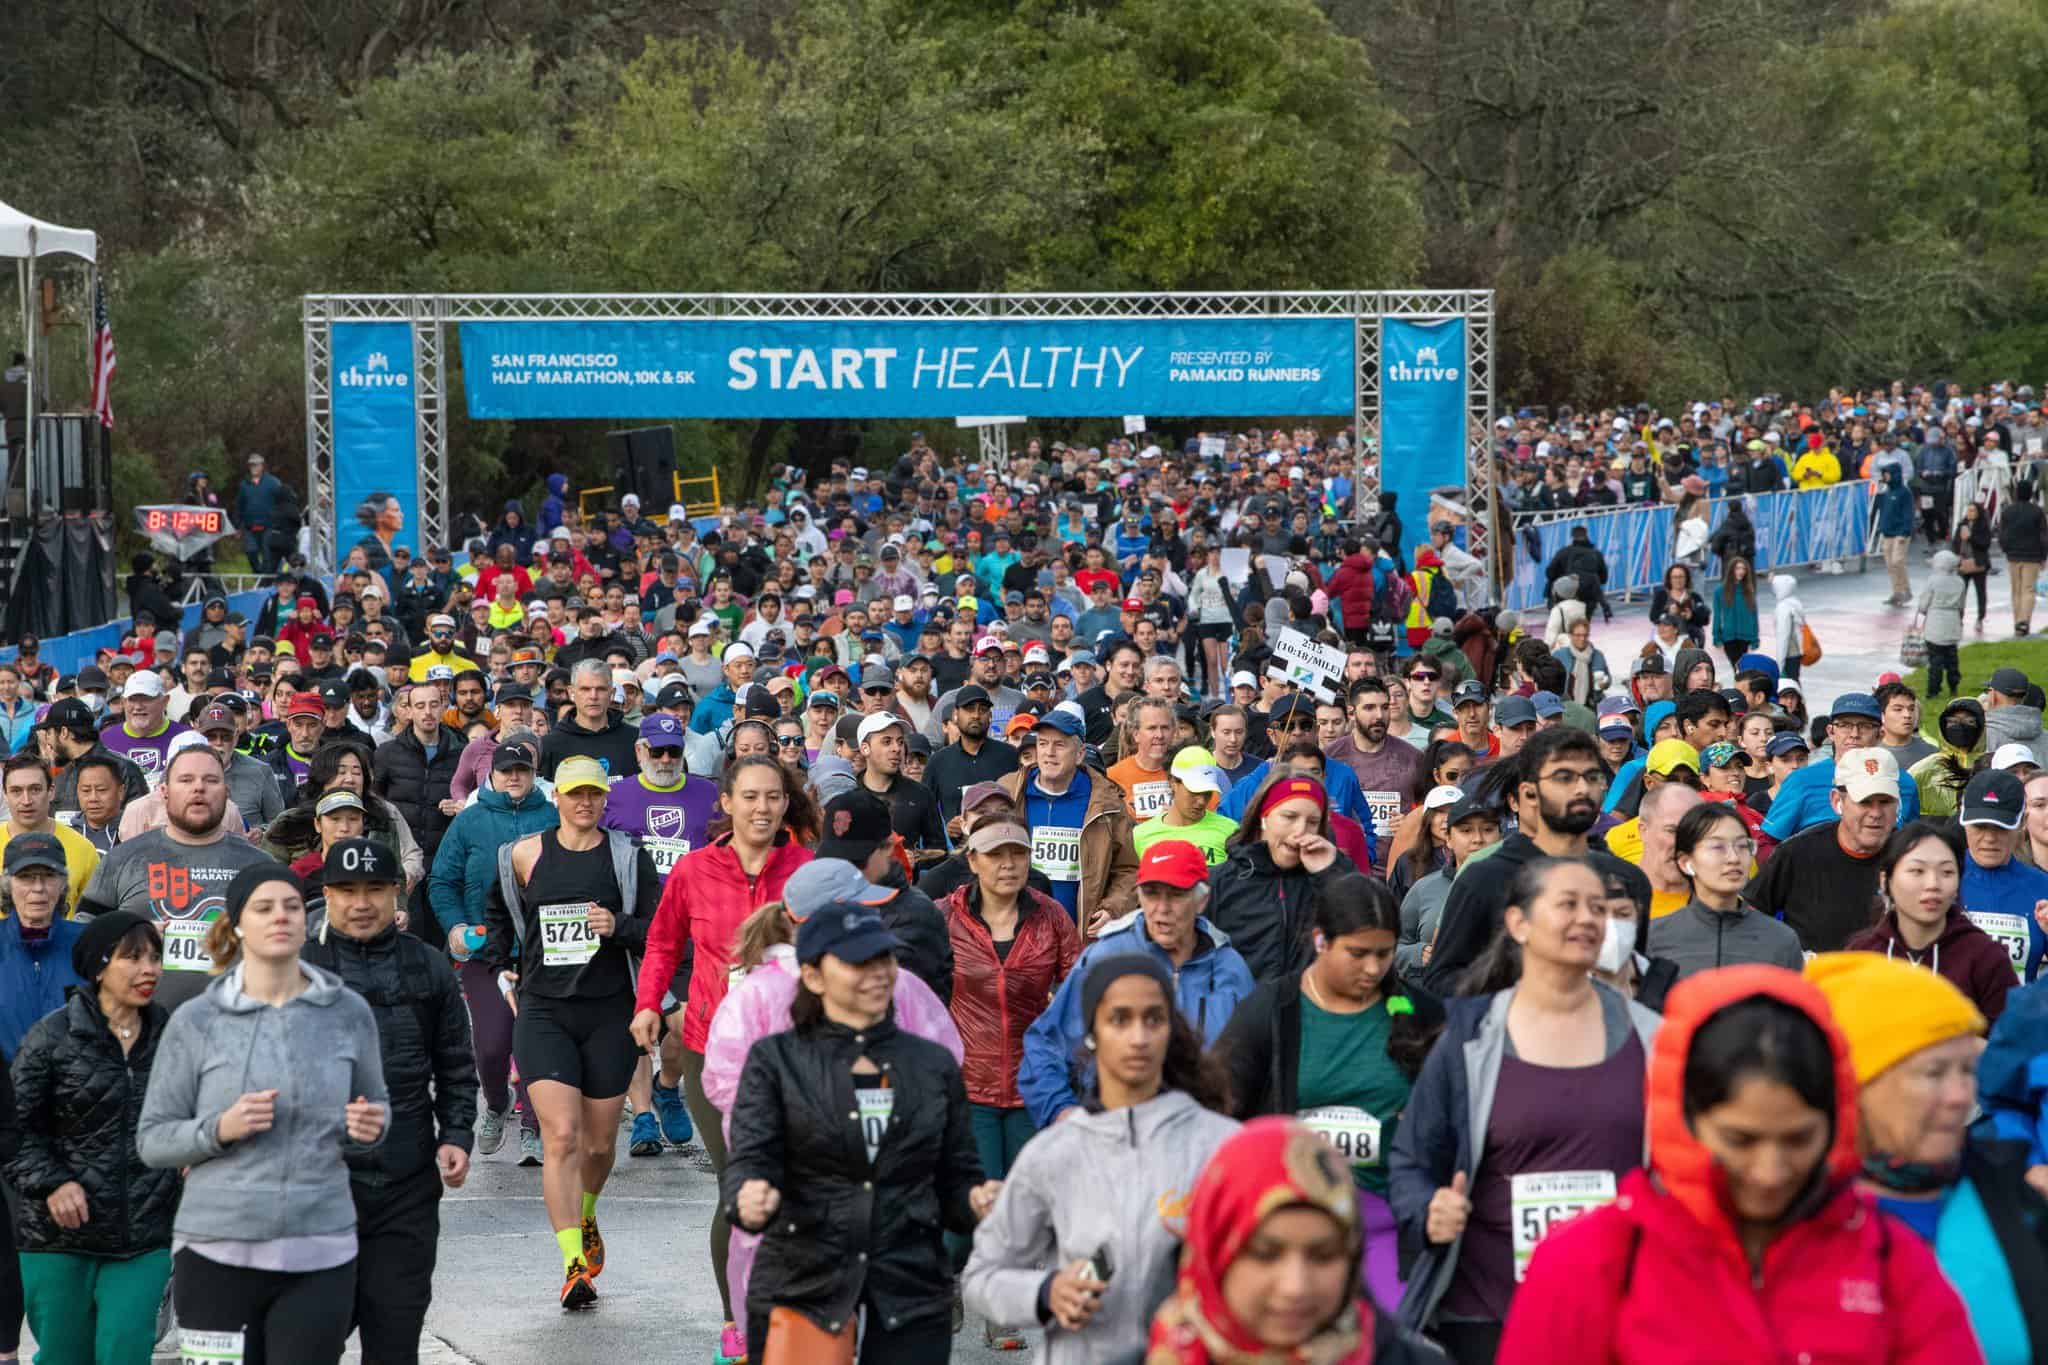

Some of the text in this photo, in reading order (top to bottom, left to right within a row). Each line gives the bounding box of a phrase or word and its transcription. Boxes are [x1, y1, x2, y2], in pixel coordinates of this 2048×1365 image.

[491, 354, 617, 367] SAN FRANCISCO
[727, 346, 1144, 390] START HEALTHY
[1170, 351, 1273, 365] PRESENTED BY
[340, 367, 407, 387] thrive
[492, 371, 533, 385] HALF
[662, 372, 674, 384] &
[676, 371, 694, 384] 5K
[1169, 368, 1320, 382] PAMAKID RUNNERS
[1389, 361, 1459, 382] thrive
[148, 510, 219, 532] 8:12:48
[1301, 638, 1326, 655] 2:15
[1276, 640, 1341, 677] (10:18/MILE)
[1035, 842, 1079, 862] 5800
[545, 920, 596, 944] 5726
